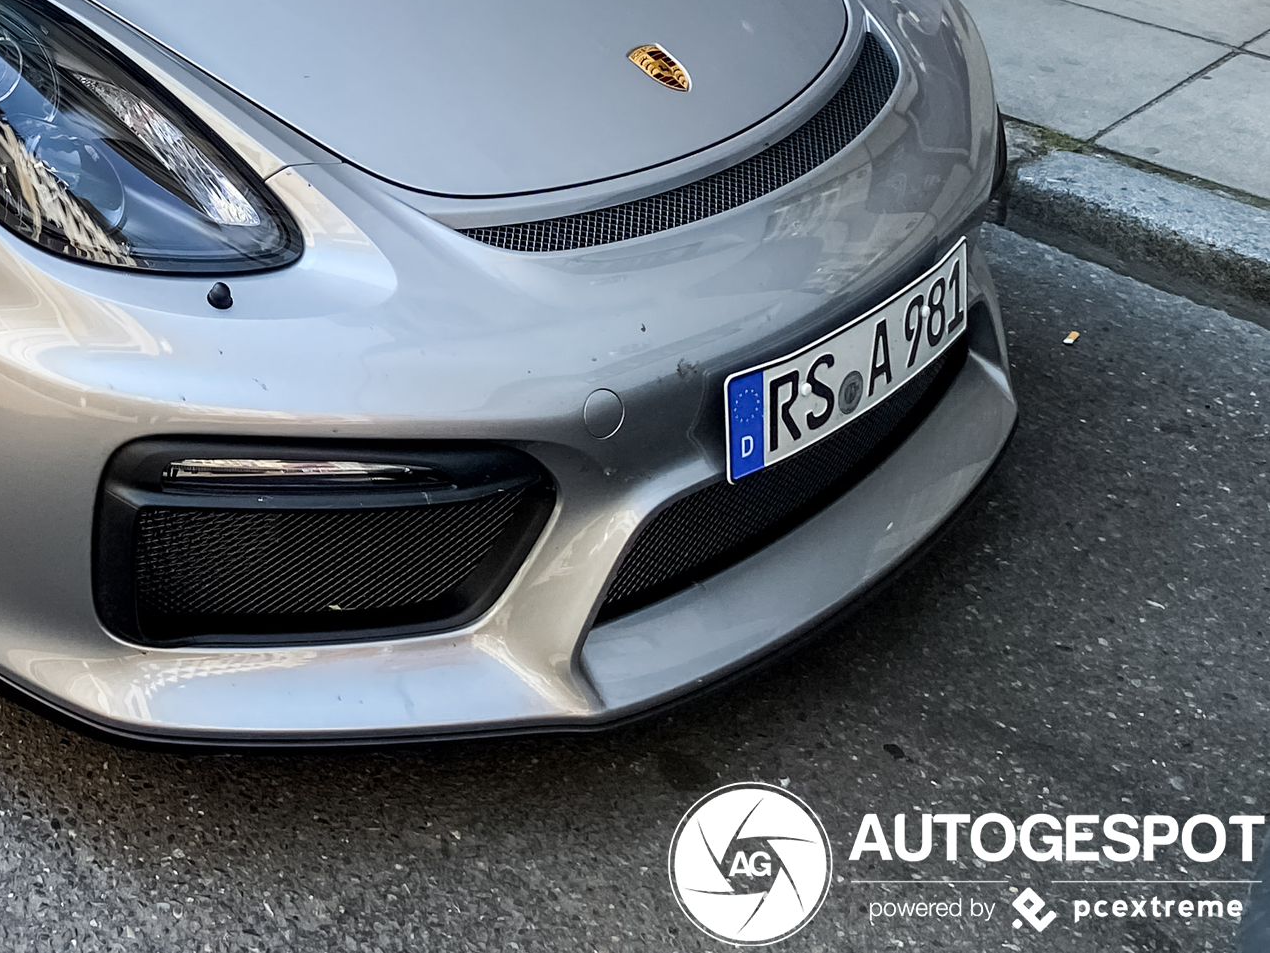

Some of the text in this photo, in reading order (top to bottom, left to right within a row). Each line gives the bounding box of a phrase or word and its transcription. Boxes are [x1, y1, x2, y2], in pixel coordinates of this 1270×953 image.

[768, 258, 966, 453] RS A 981
[741, 435, 755, 459] D
